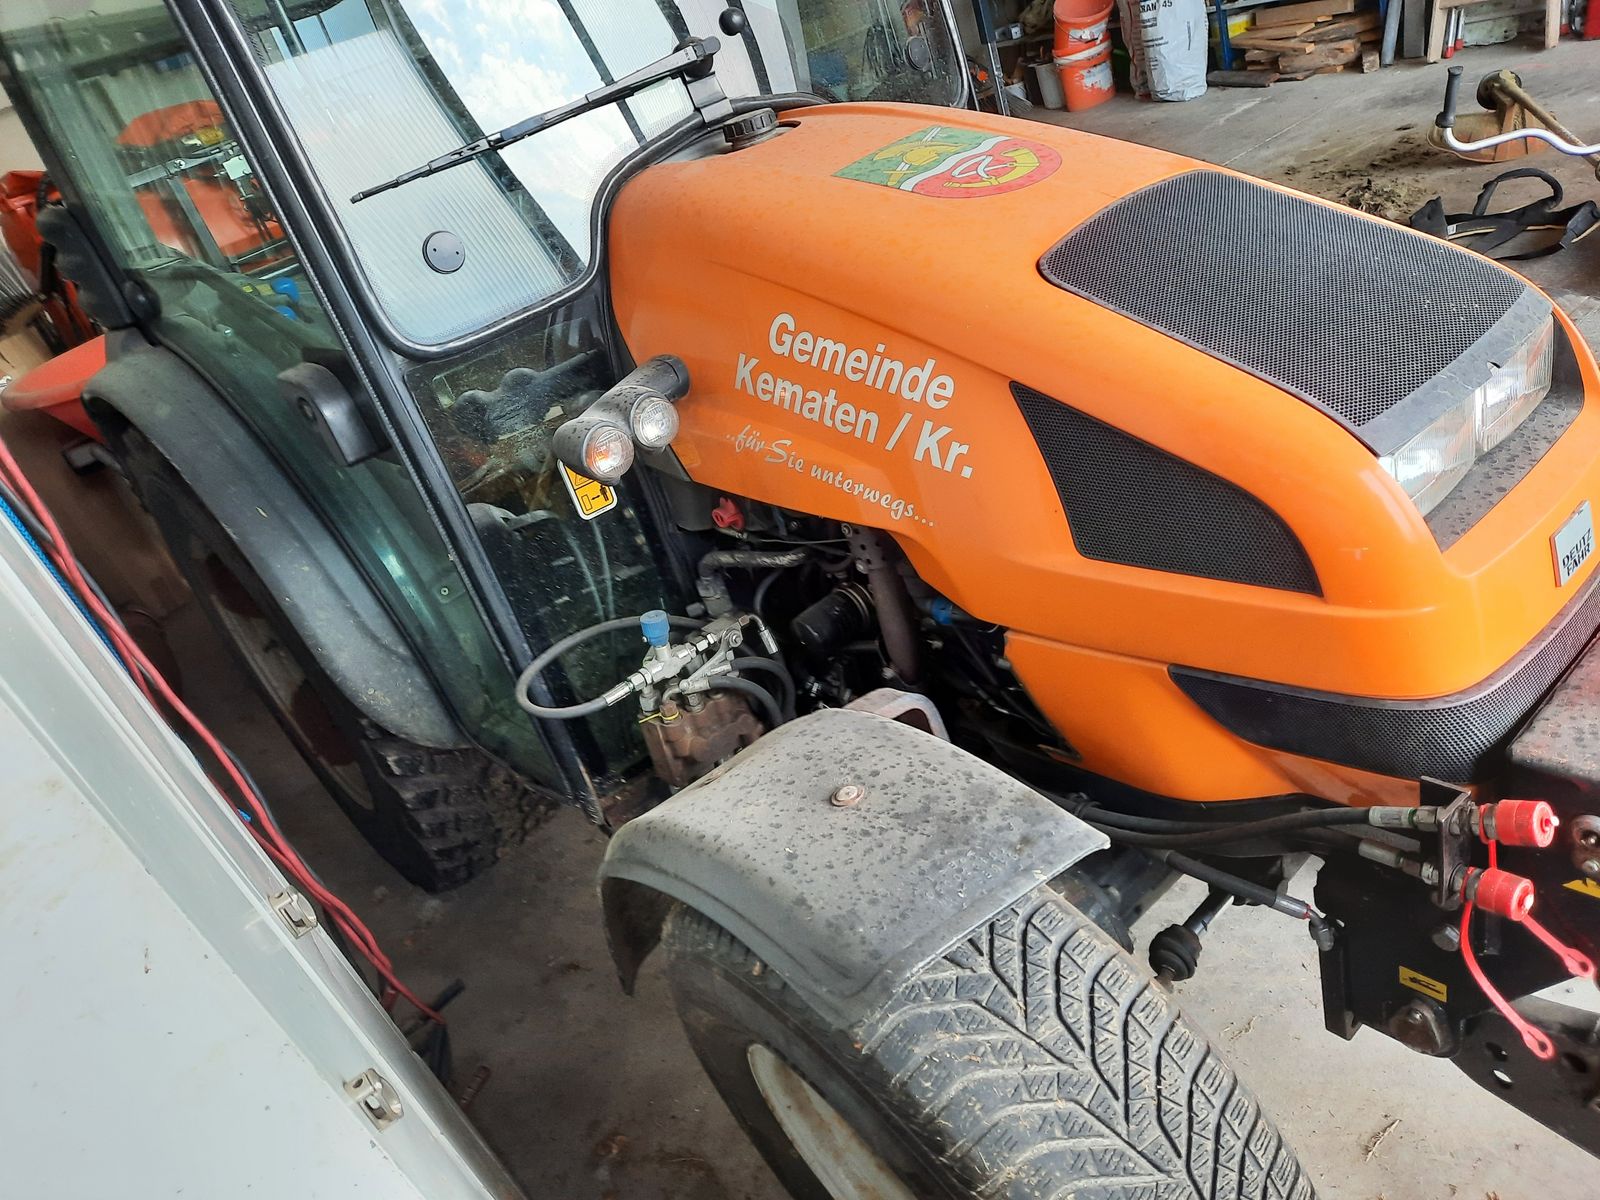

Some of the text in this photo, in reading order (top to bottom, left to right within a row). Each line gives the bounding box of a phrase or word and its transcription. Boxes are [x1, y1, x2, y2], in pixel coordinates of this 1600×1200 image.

[768, 313, 955, 410] Gemeinde
[734, 352, 974, 479] Kematen / Kr.
[764, 439, 804, 474] Sie
[810, 463, 934, 527] unterwegs...
[1562, 527, 1592, 569] DEUTZ
[1566, 543, 1591, 576] FAHR
